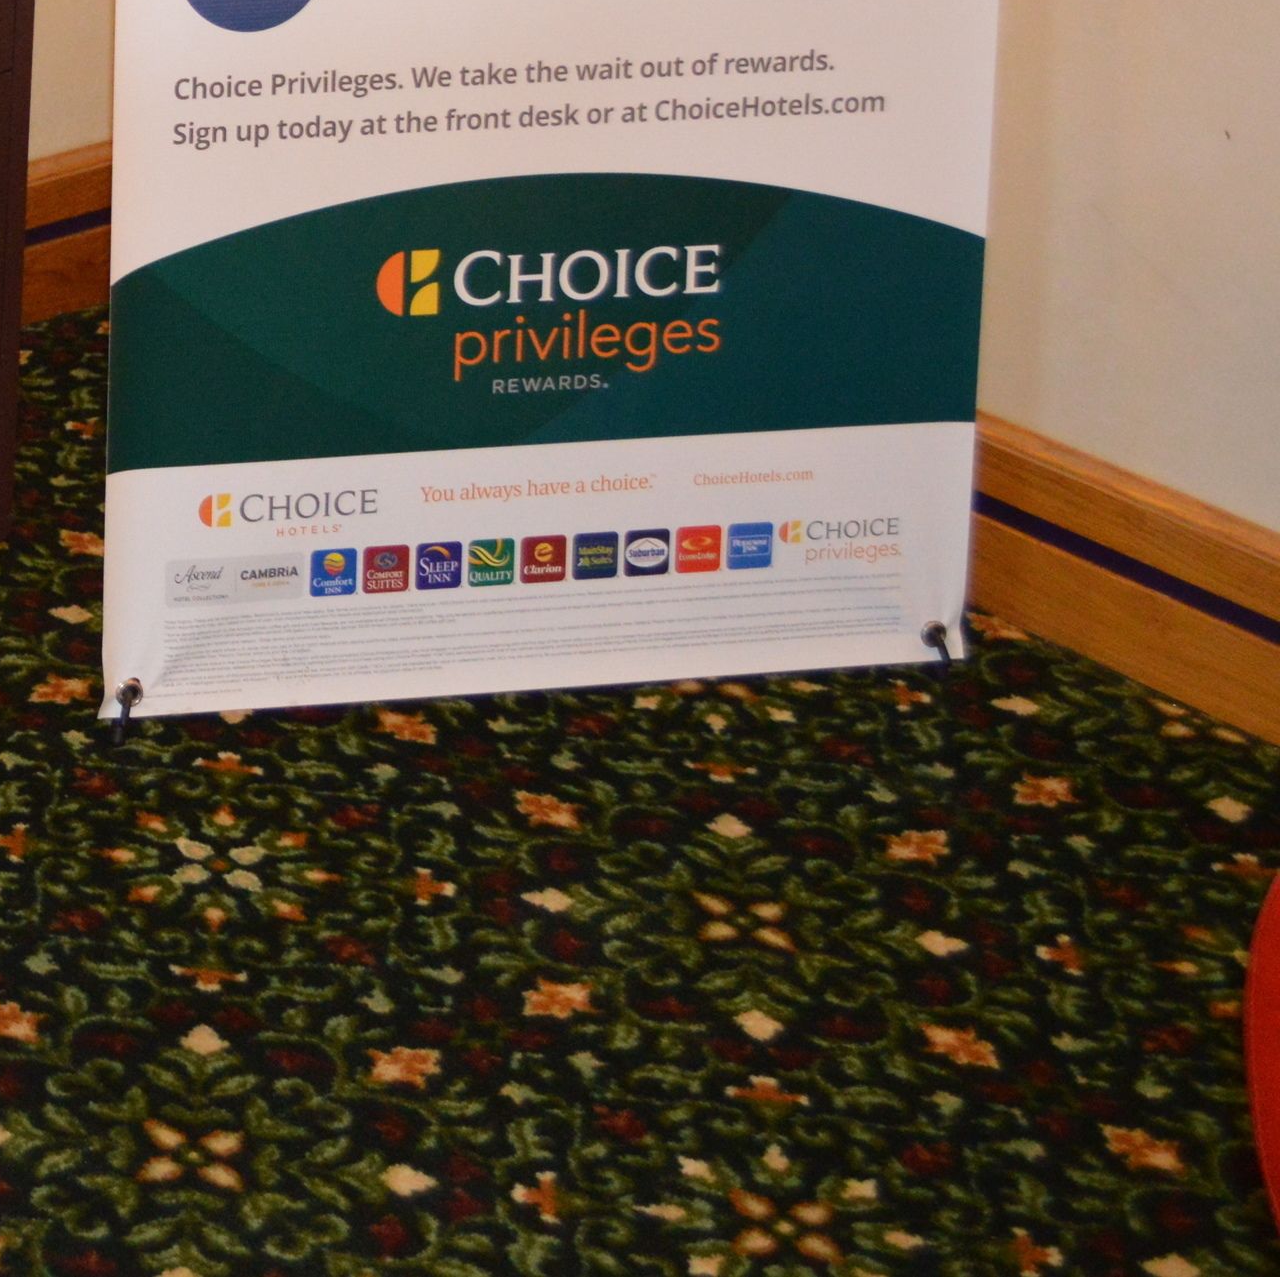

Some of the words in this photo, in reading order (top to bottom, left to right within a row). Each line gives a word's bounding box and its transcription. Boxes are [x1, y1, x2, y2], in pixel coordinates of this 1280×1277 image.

[174, 74, 263, 102] Choice
[271, 70, 404, 101] Privileges.
[411, 66, 452, 91] We
[459, 62, 518, 89] take
[525, 60, 569, 86] the
[575, 56, 633, 83] wait
[639, 57, 685, 80] out
[691, 52, 720, 79] of
[724, 48, 835, 77] rewards.
[172, 121, 228, 152] Sign
[236, 124, 270, 150] up
[277, 115, 354, 146] today
[359, 115, 387, 138] at
[393, 110, 438, 136] the
[445, 108, 512, 133] front
[518, 103, 580, 130] desk
[586, 107, 615, 126] or
[620, 102, 648, 125] at
[654, 93, 885, 124] ChoiceHotels.com
[453, 243, 722, 308] CHOICE
[453, 308, 723, 383] privileges
[692, 469, 814, 488] ChoiceHotels.com
[420, 486, 455, 505] You
[459, 482, 523, 505] always
[526, 479, 571, 499] have
[574, 480, 586, 496] a
[239, 487, 380, 524] CHOICE
[806, 517, 901, 541] CHOICE
[627, 547, 667, 560] Suburban
[418, 557, 460, 577] SLEEP
[468, 570, 514, 583] QUALITY
[523, 563, 563, 576] Clarion
[311, 577, 354, 589] Comfort
[365, 578, 405, 592] SUITES
[428, 573, 452, 584] INN
